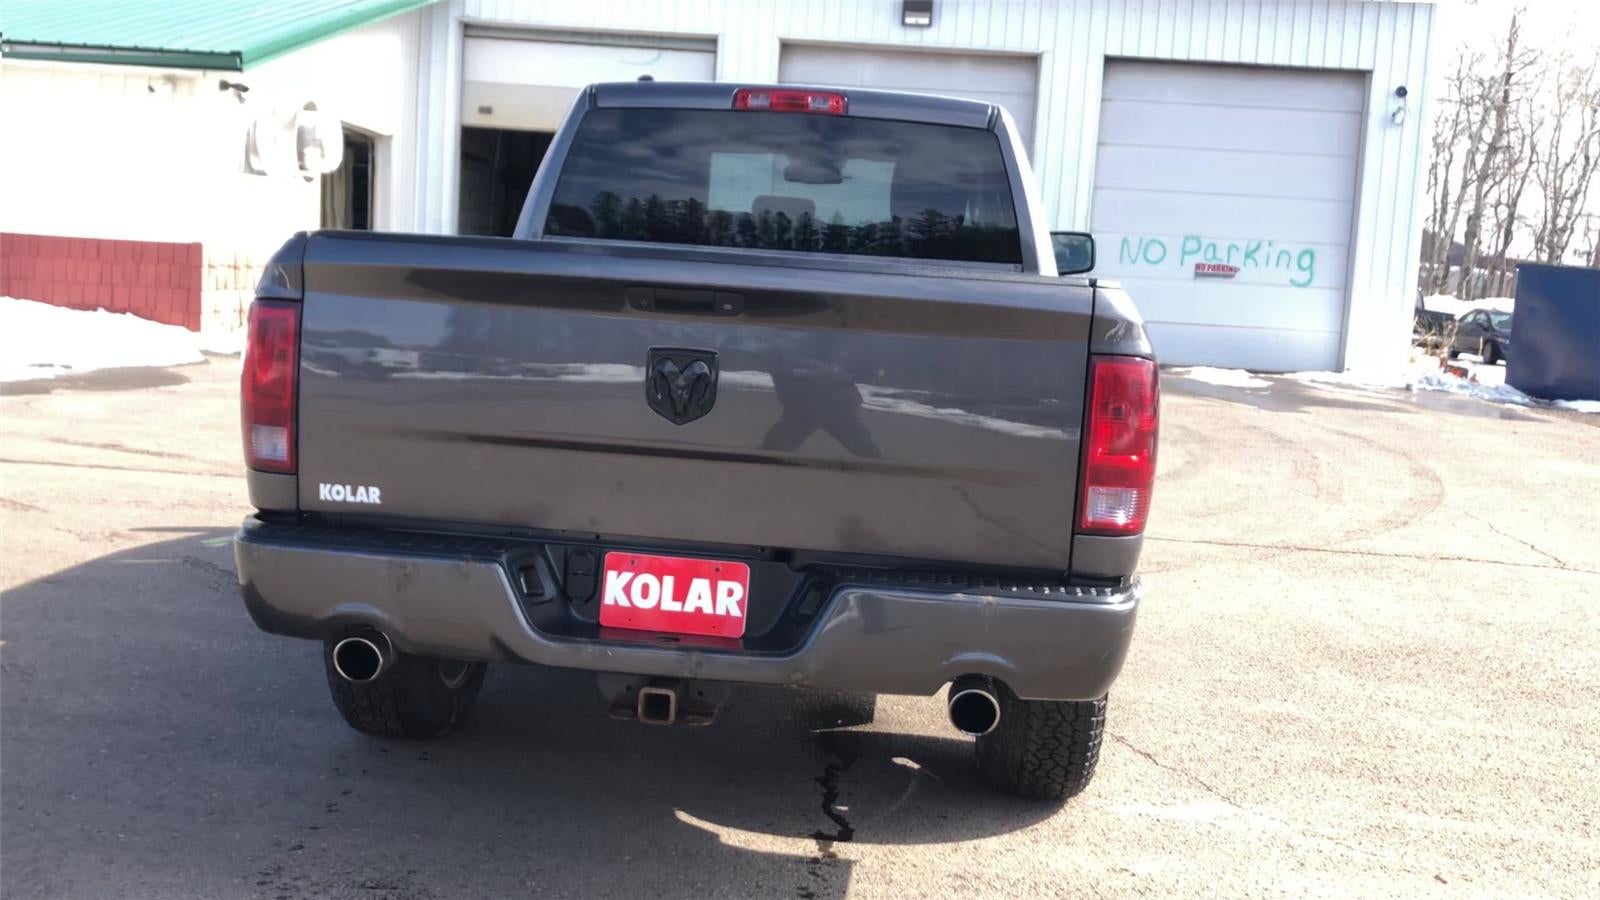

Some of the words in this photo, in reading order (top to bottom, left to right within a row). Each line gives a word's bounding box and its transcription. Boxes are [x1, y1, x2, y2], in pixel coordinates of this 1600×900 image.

[1195, 263, 1206, 272] NO
[319, 483, 381, 504] KOLAR
[603, 569, 744, 617] KOLAR
